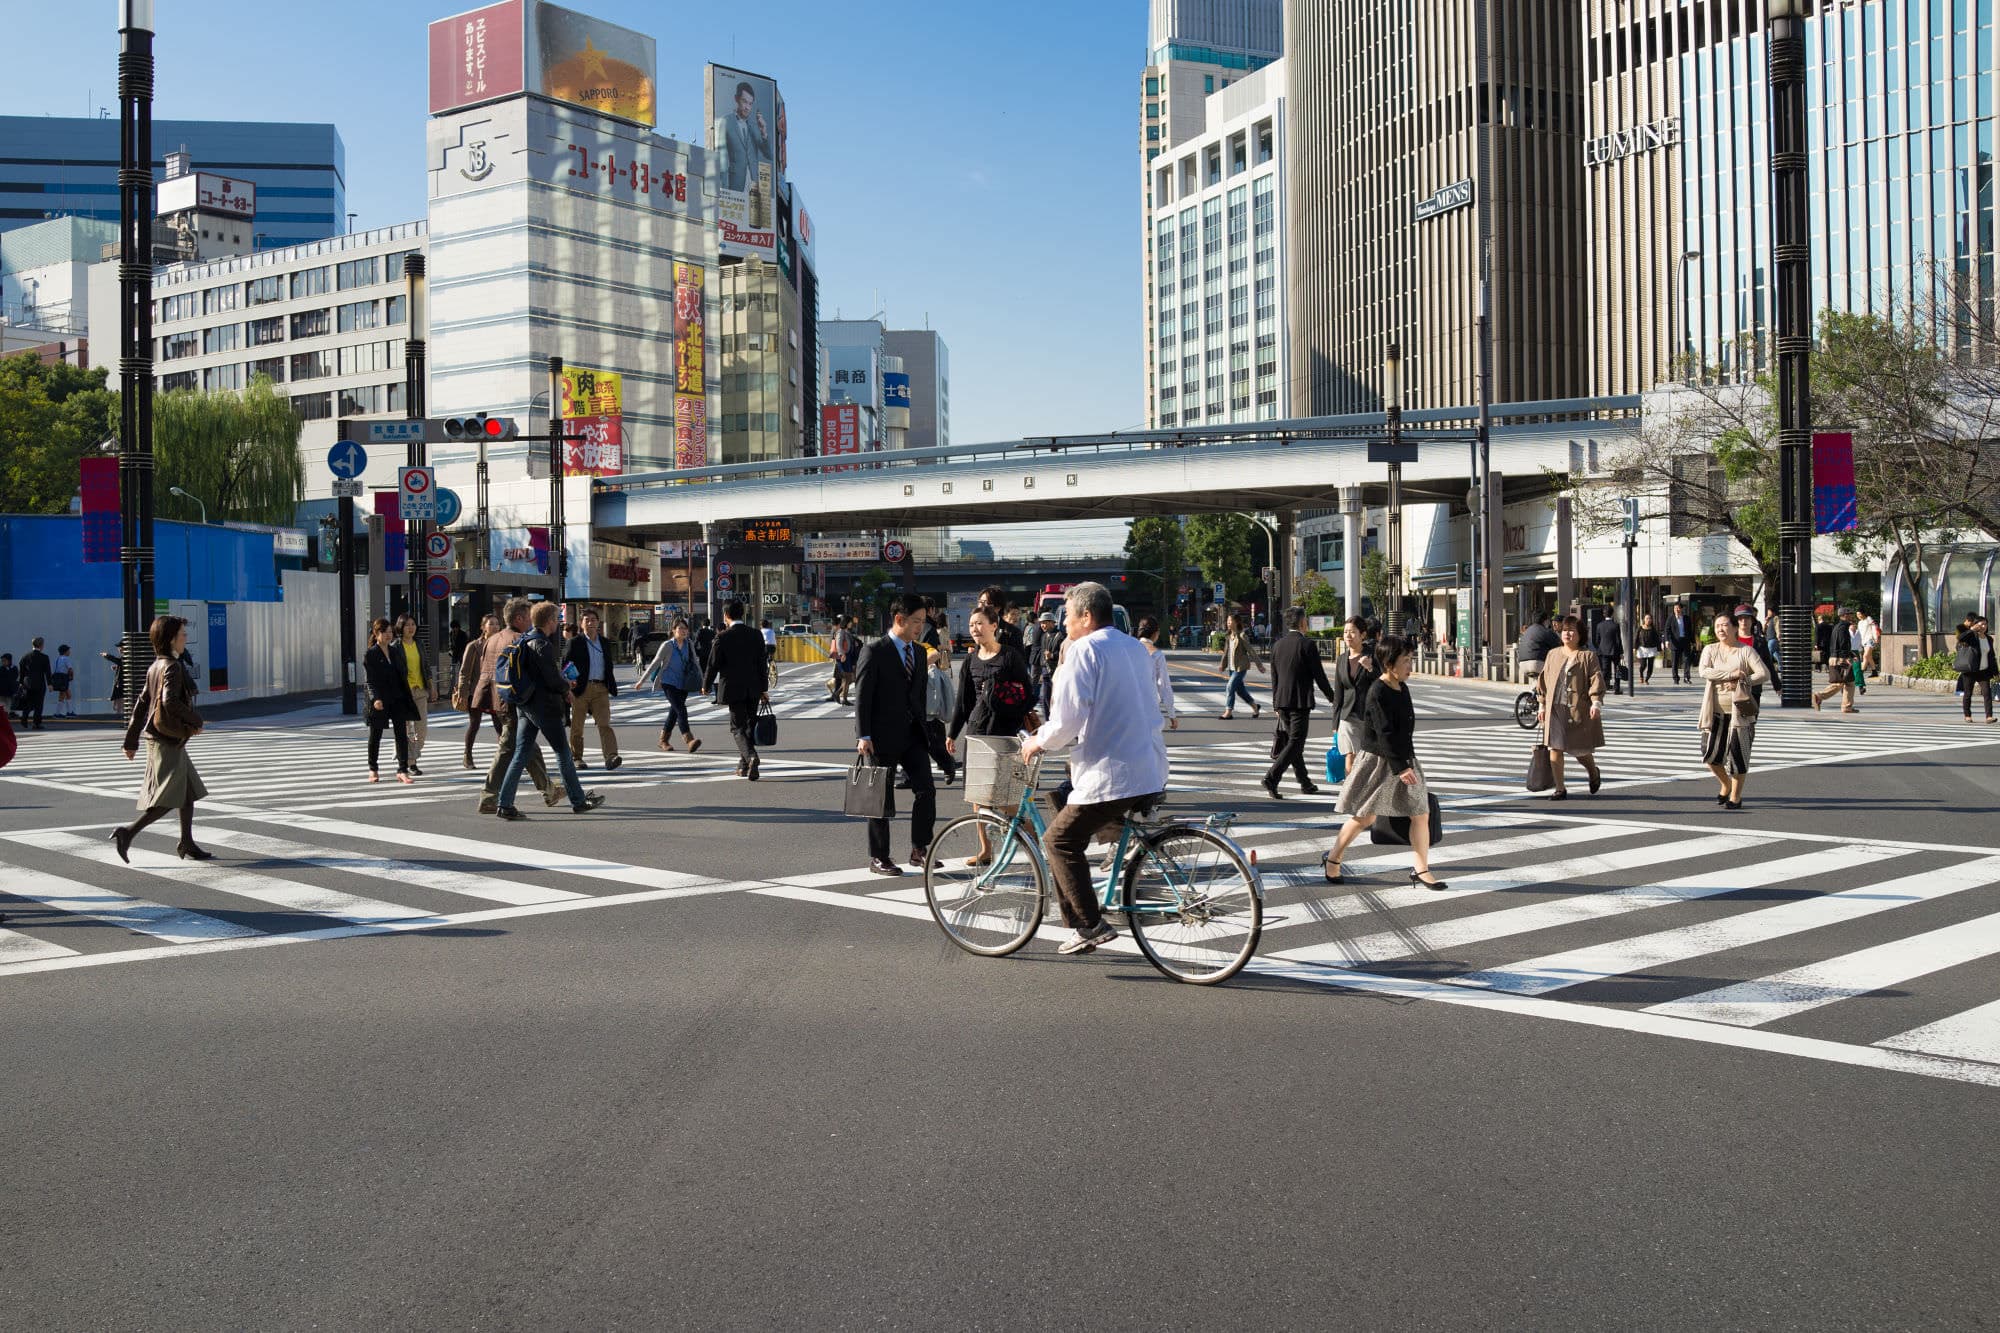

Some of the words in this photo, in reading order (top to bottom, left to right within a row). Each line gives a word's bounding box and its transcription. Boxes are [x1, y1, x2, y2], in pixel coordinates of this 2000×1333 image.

[579, 87, 619, 101] SAPPORO
[1583, 115, 1680, 166] LUMINE
[745, 528, 791, 542] 高さ制限
